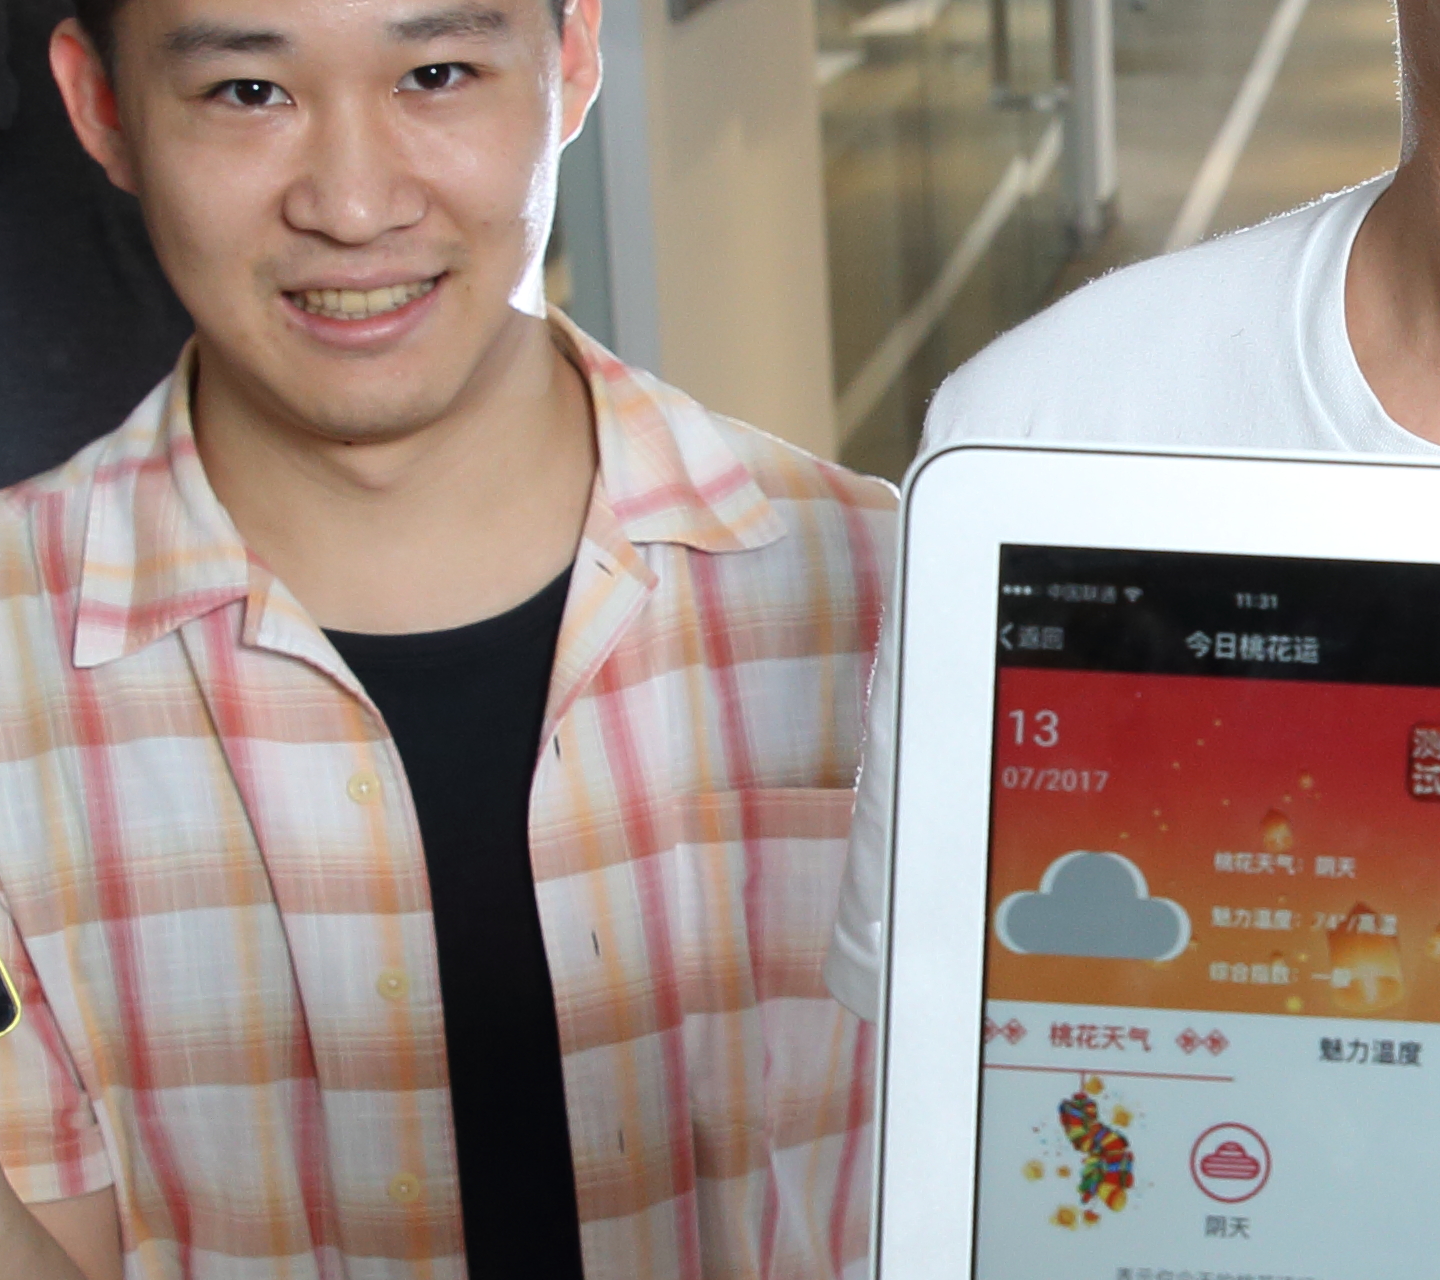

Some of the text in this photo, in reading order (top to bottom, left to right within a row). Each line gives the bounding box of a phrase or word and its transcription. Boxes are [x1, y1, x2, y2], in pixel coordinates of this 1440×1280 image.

[1018, 625, 1320, 664] 返回 今日桃花运
[1009, 709, 1060, 748] 13
[1002, 768, 1109, 794] 07/2017
[1049, 1022, 1423, 1068] 桃花天气 魅力温度
